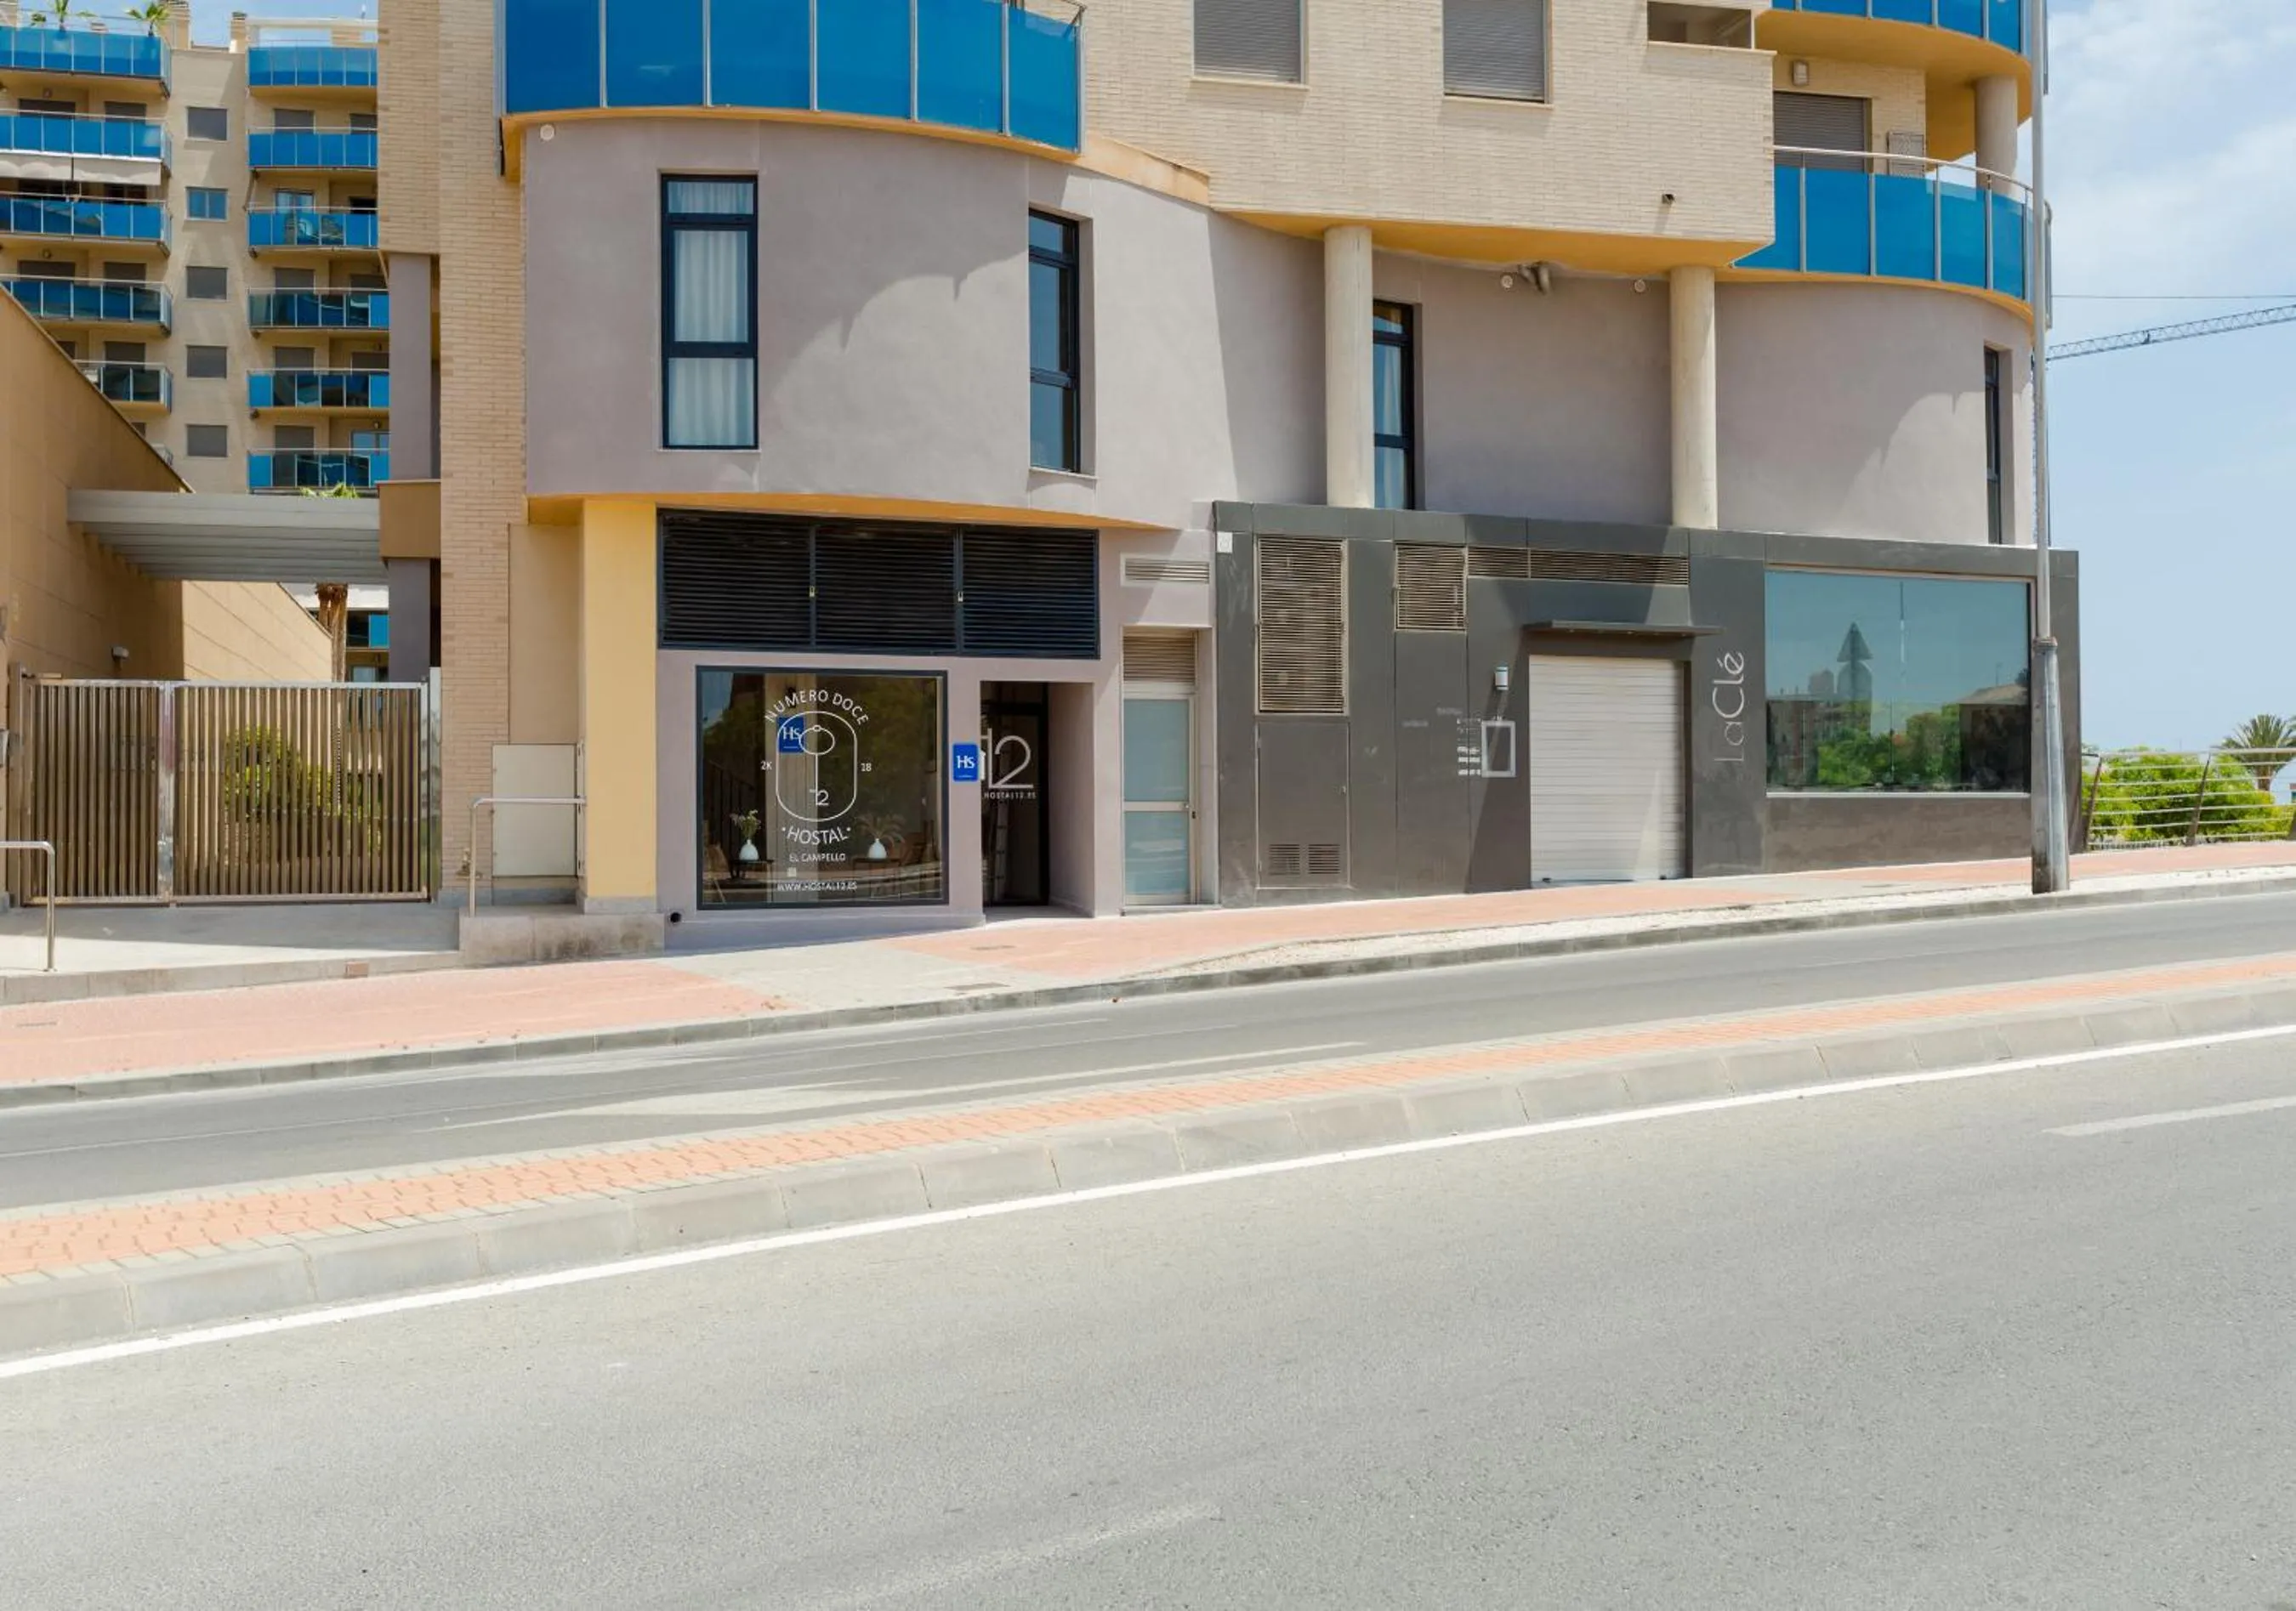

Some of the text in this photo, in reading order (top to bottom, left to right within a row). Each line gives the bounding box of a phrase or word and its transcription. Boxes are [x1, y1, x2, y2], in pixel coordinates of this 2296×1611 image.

[764, 689, 868, 725] NUMERO DOCE
[957, 755, 975, 769] HS
[801, 853, 846, 862] CAMPELLO
